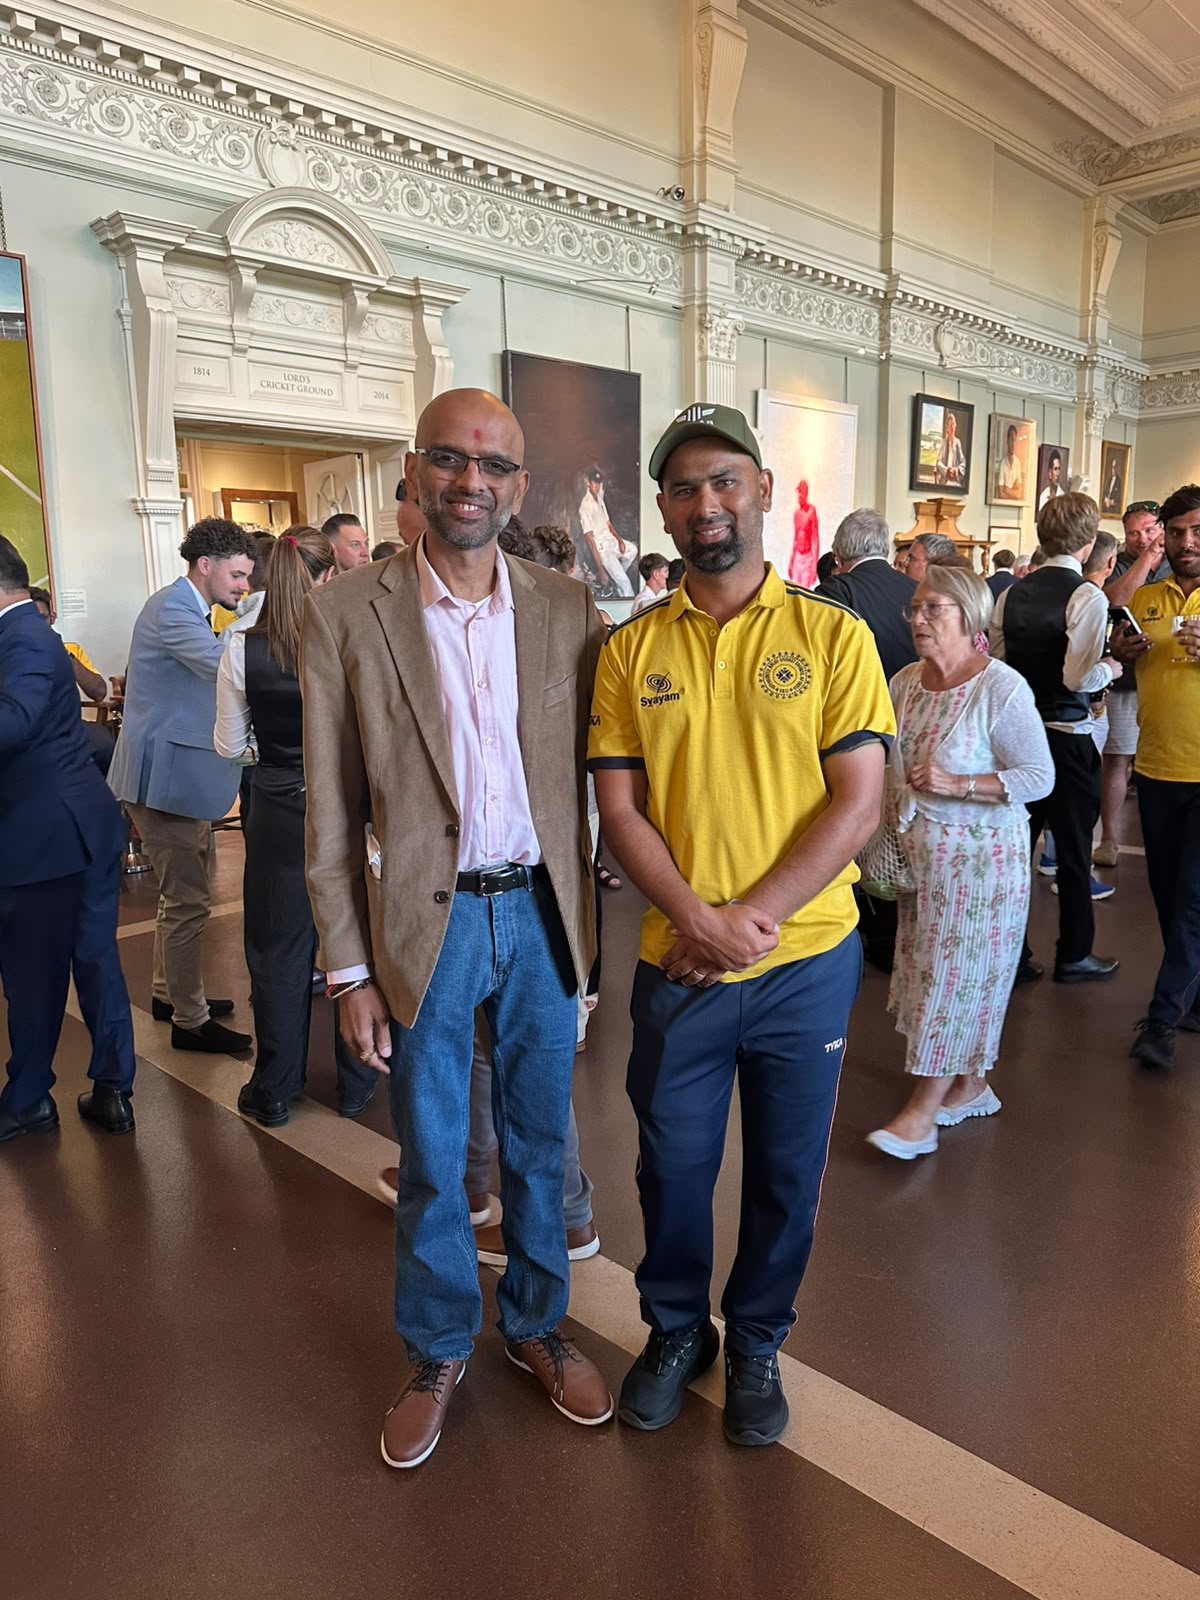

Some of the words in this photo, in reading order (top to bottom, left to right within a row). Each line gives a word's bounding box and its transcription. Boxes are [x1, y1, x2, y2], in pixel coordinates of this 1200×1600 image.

[193, 367, 211, 377] 1814
[283, 372, 311, 384] LORD'S
[260, 379, 295, 392] CRICKET
[296, 384, 334, 397] GROUND
[373, 390, 389, 401] 2014
